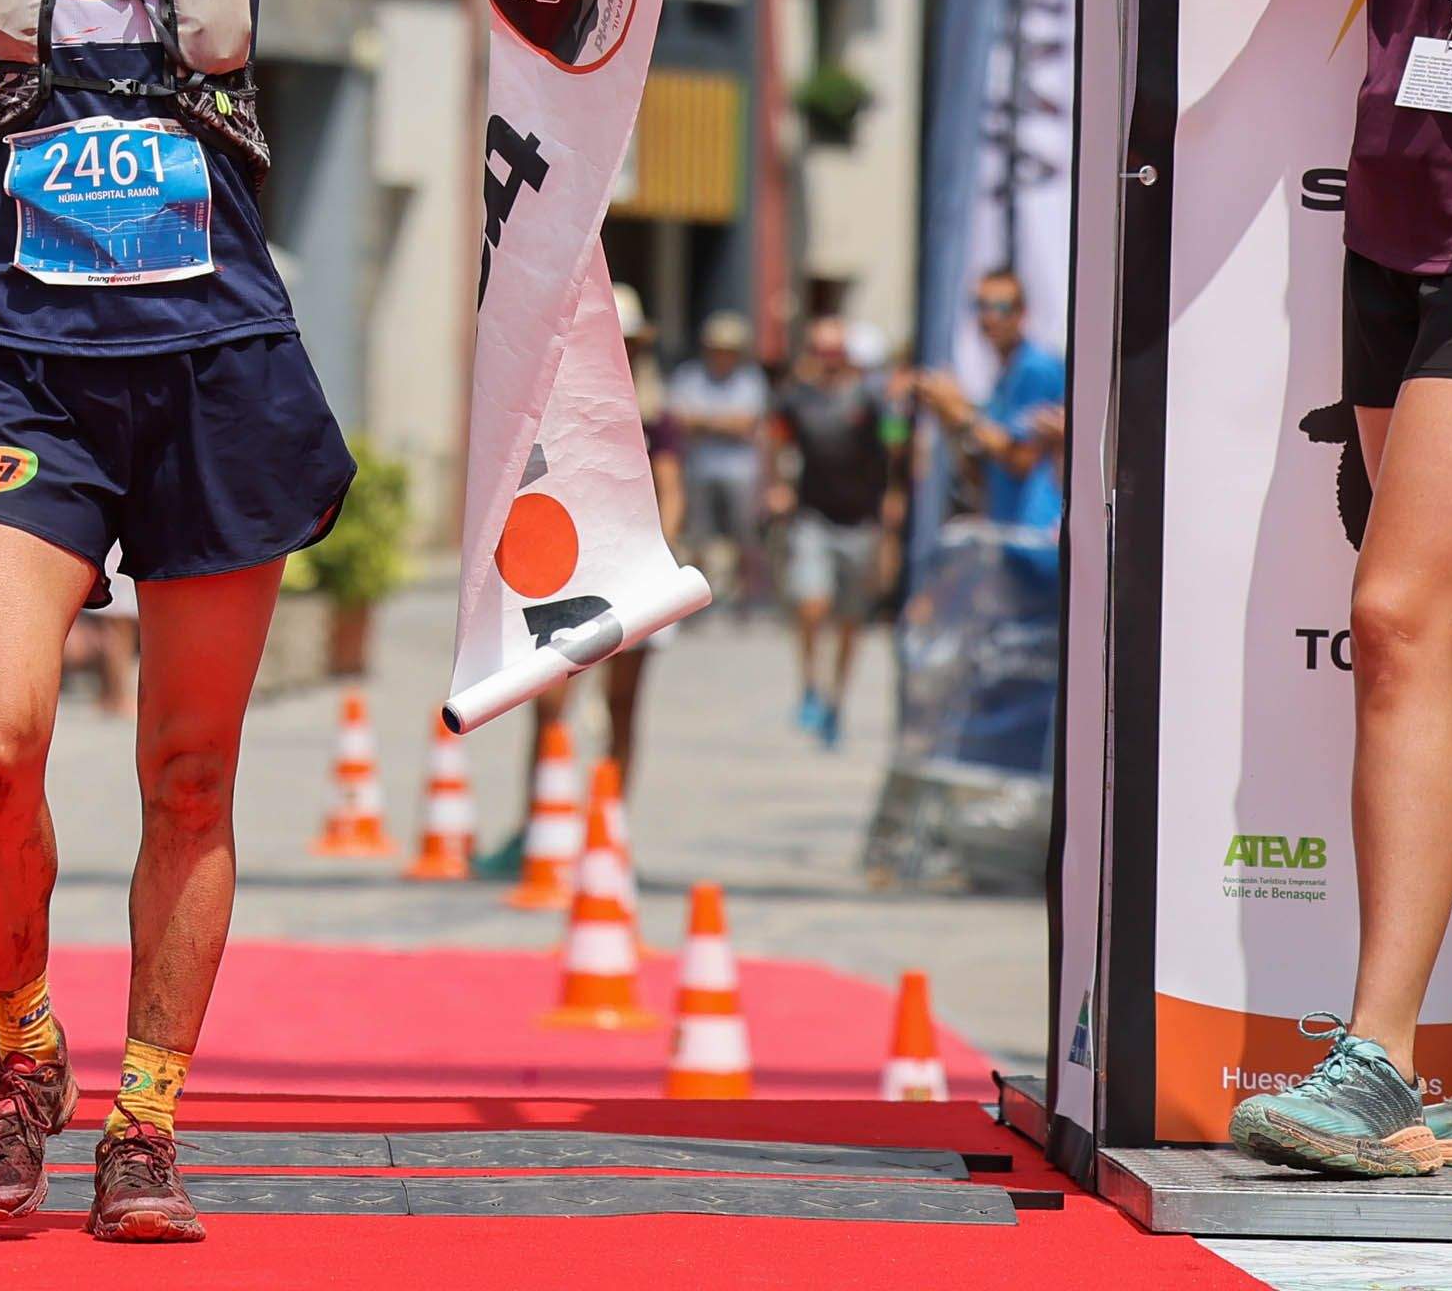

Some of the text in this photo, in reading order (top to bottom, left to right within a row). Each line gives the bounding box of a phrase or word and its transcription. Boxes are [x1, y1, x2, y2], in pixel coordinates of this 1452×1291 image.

[42, 133, 165, 192] 2461
[85, 189, 127, 202] HOSPITAL
[128, 186, 160, 199] RAMÓN
[1223, 886, 1327, 903] Valle de Benasque
[1222, 1066, 1309, 1092] Huesc
